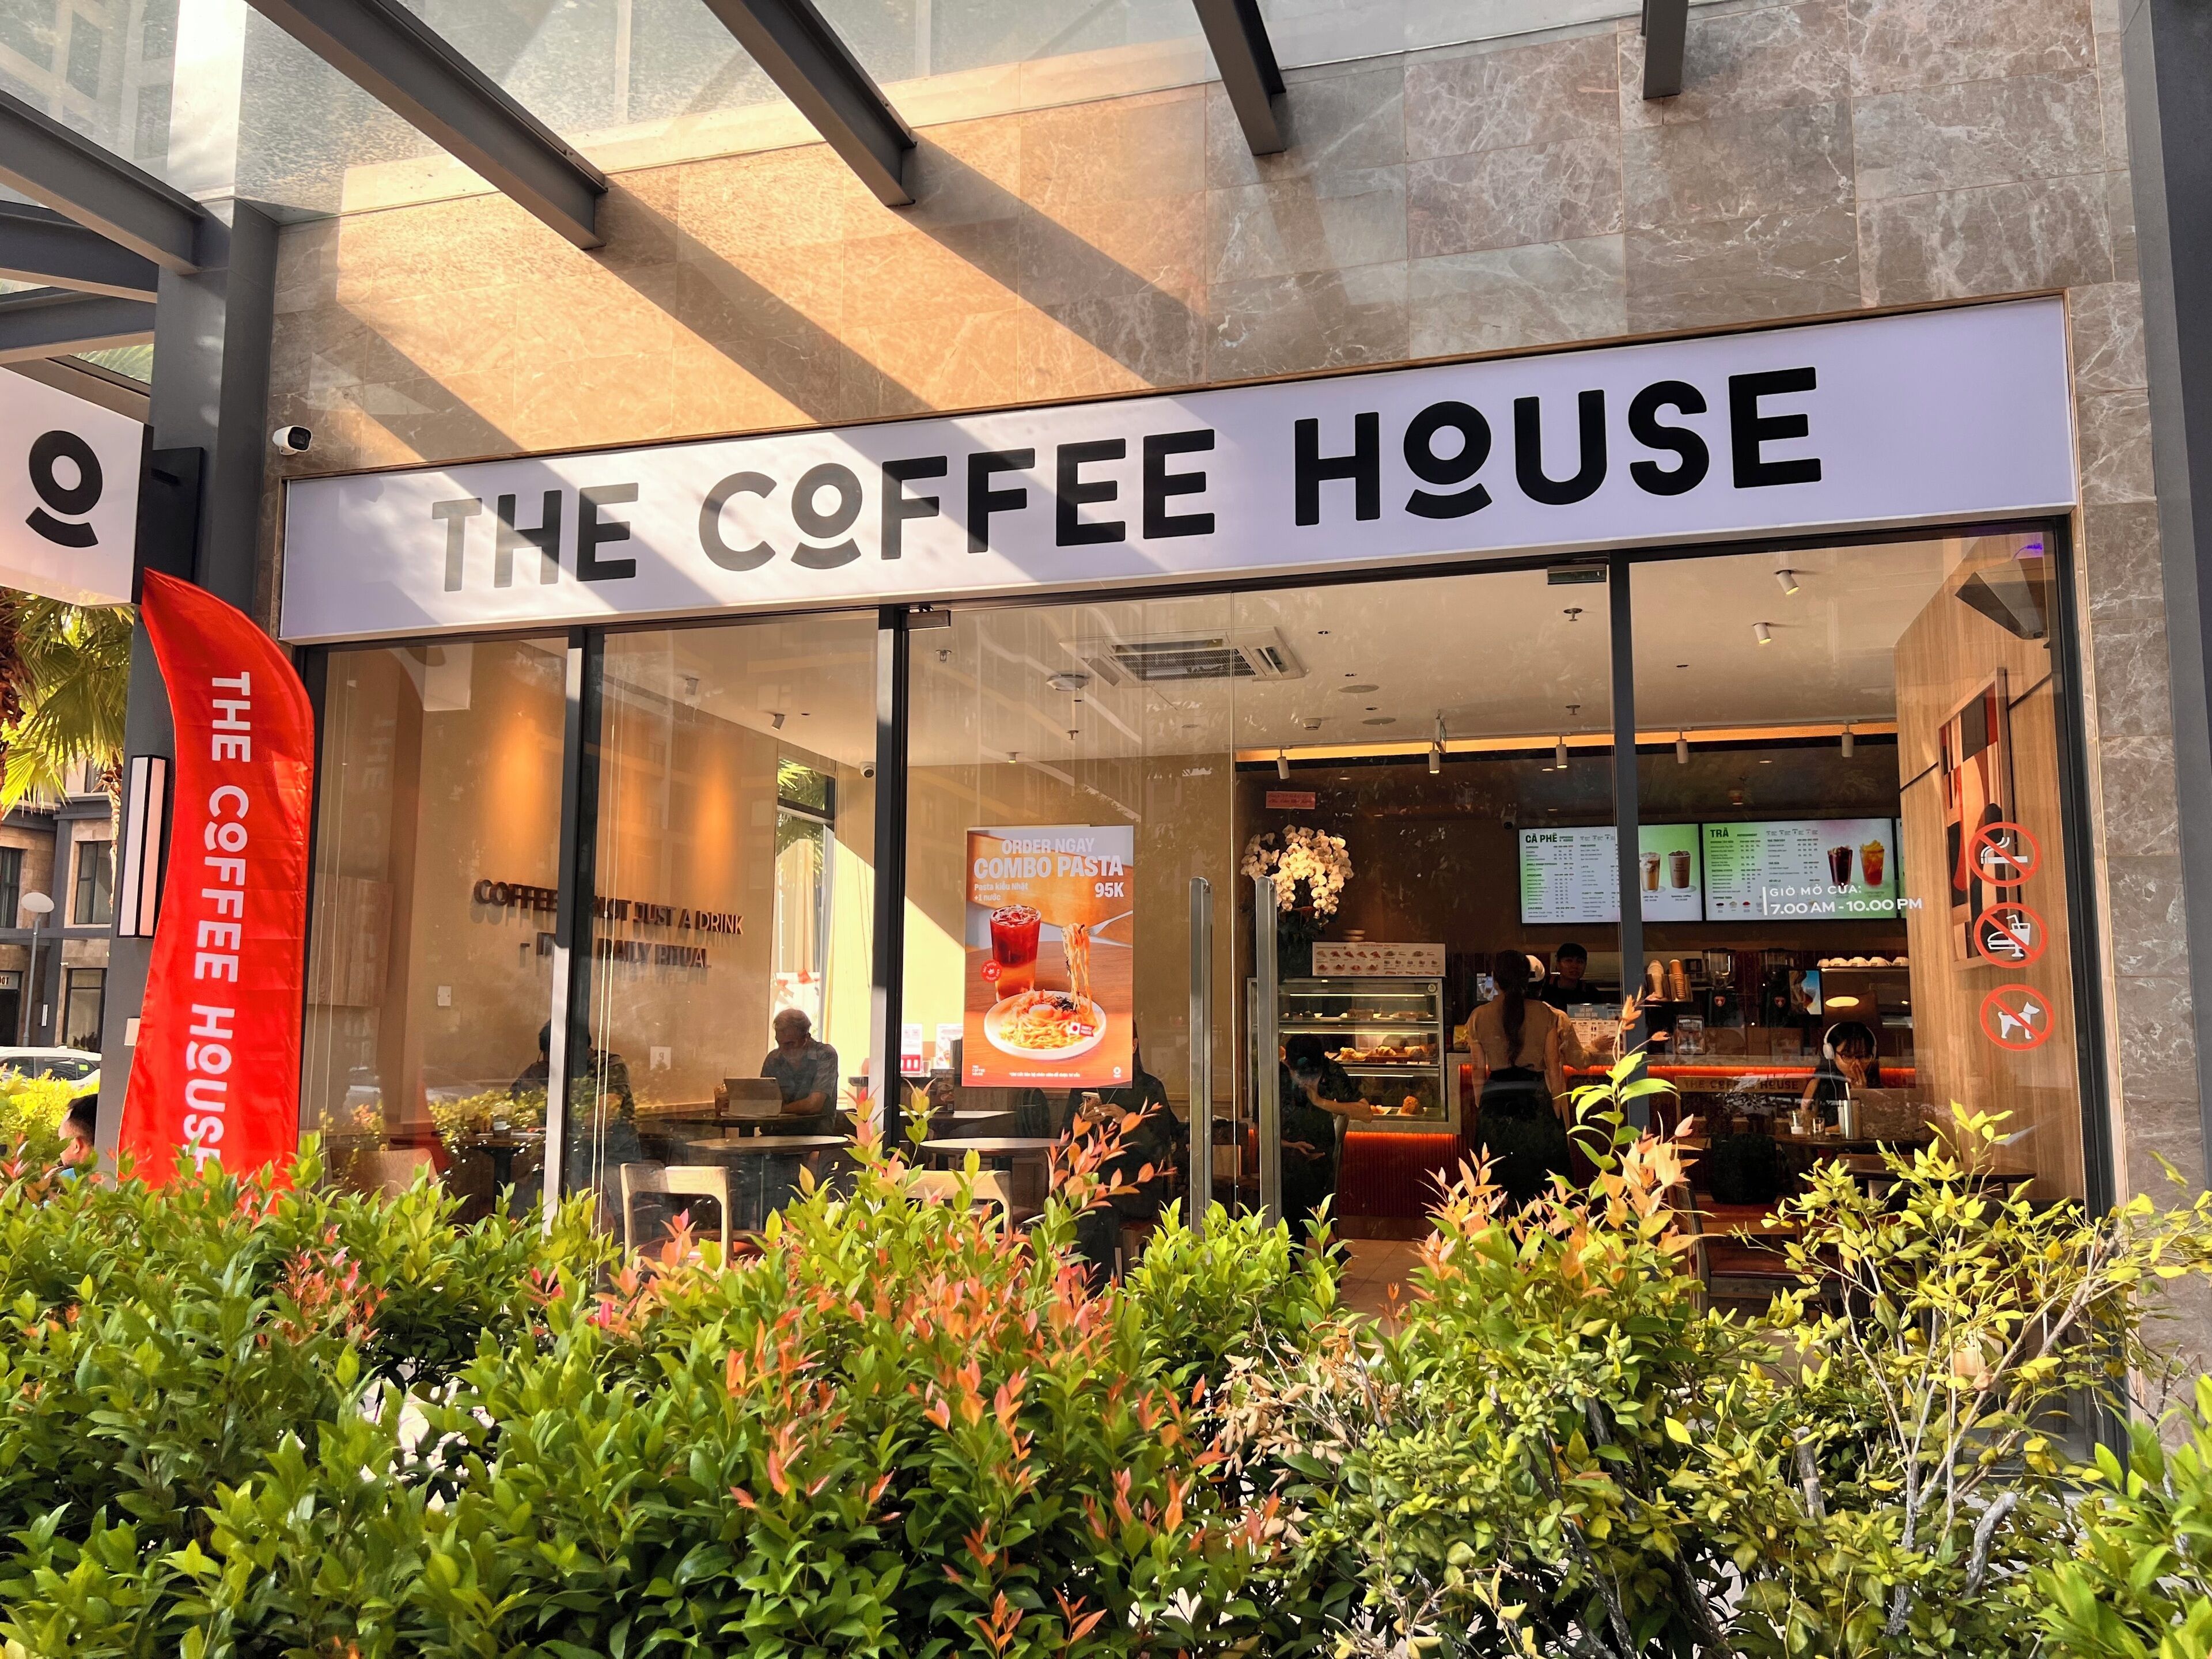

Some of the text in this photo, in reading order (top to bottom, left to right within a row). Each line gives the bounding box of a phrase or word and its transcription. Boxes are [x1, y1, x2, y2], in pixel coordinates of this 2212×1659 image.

[432, 366, 1821, 592] THE COFFEE HOUSE
[211, 671, 251, 763] THE
[1525, 833, 1537, 843] CÀ
[1540, 832, 1558, 843] PHÊ
[1710, 827, 1729, 838] TRÀ
[1001, 837, 1094, 855] ORDER NGAY
[974, 854, 1124, 879] COMBO PASTA
[193, 785, 250, 983] COFFEE
[1094, 881, 1124, 898] 95K
[1770, 885, 1796, 897] GIỜ
[1801, 884, 1823, 895] MỞ
[1827, 882, 1862, 895] CỬA:
[593, 895, 632, 922] NOT
[634, 902, 677, 927] JUST
[678, 908, 692, 929] A
[695, 910, 744, 935] DRINK
[1770, 903, 1808, 915] 7.00
[1810, 902, 1835, 914] AM
[1846, 899, 1894, 911] 10.00
[1897, 897, 1923, 910] PM
[597, 938, 652, 965] DAILY
[654, 942, 712, 969] RITUAL
[1684, 1080, 1705, 1089] THE
[1760, 1079, 1798, 1090] HOUSE
